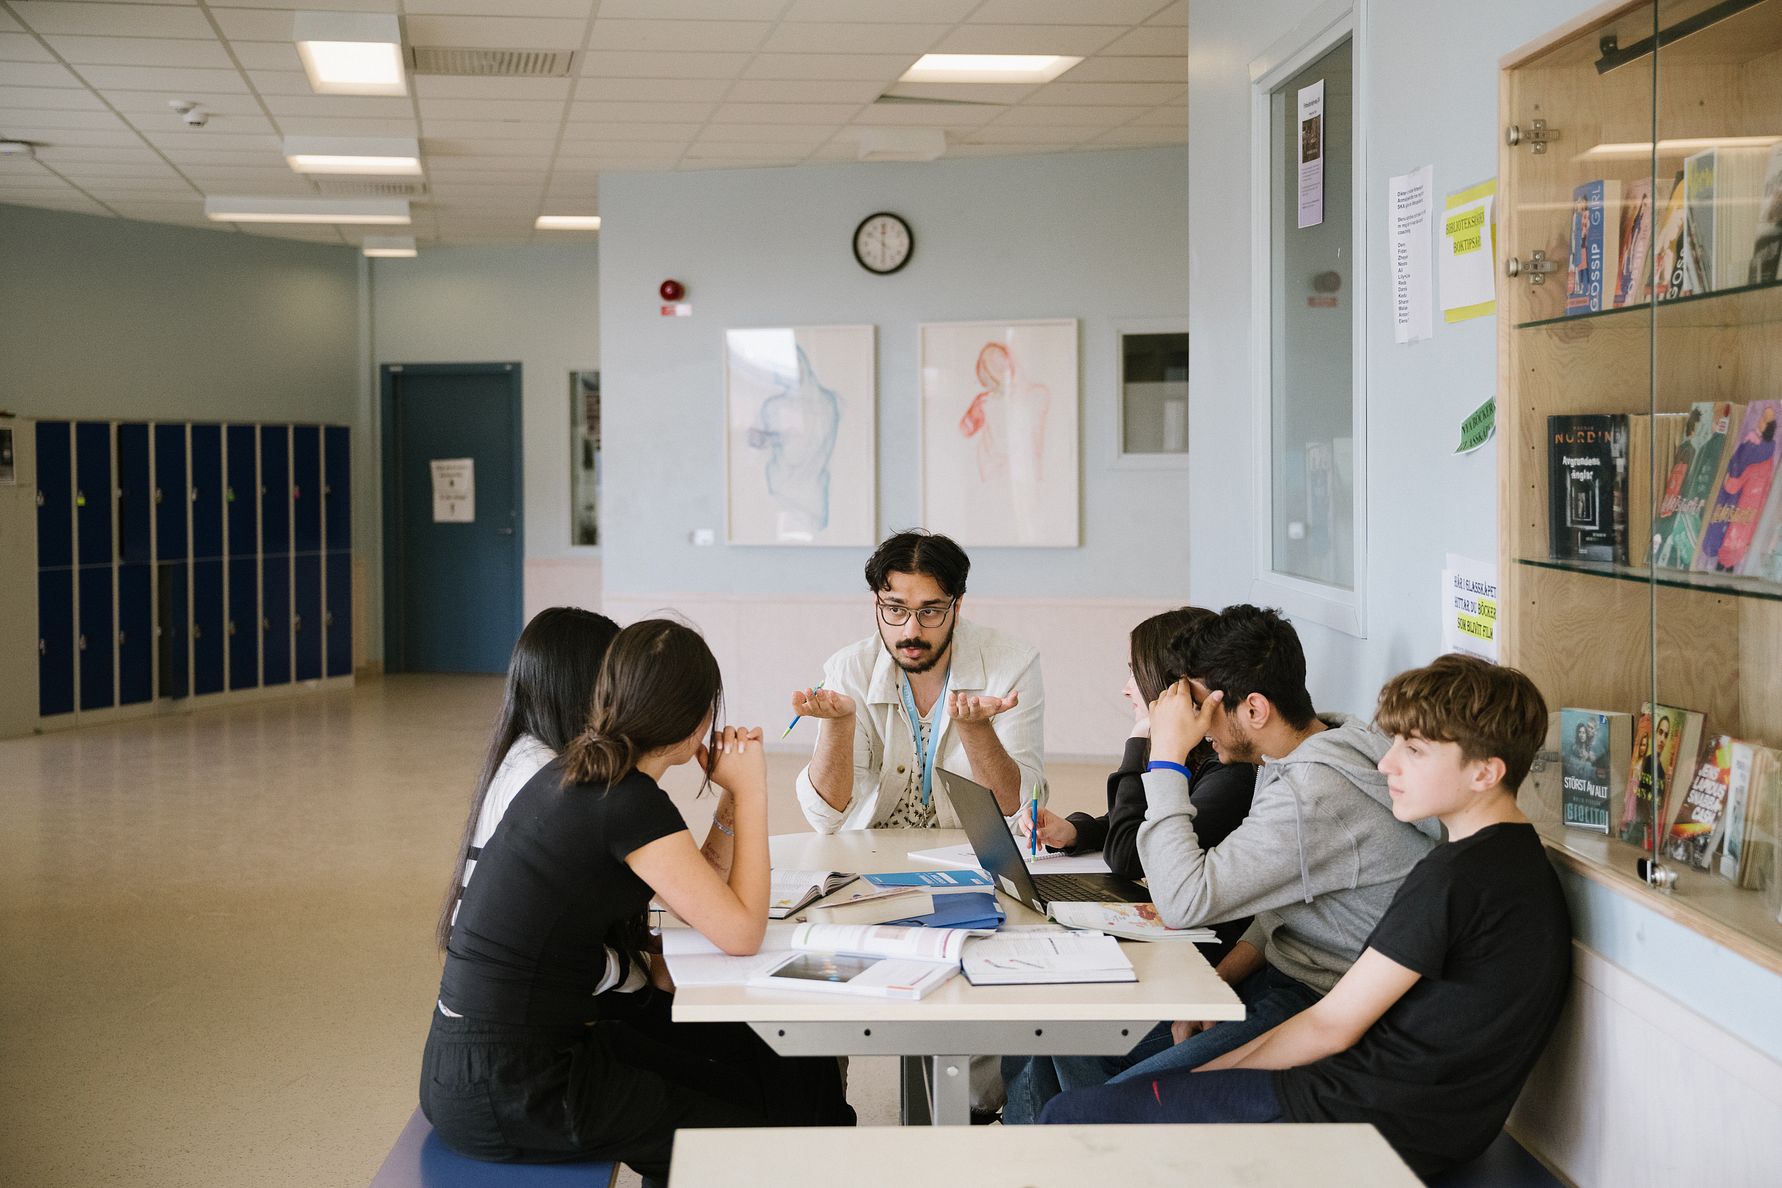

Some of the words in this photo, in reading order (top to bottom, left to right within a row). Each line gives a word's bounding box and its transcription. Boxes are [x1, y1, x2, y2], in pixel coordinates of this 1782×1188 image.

[1591, 185, 1601, 226] GIRL
[1590, 243, 1601, 312] GOSSIP
[1555, 431, 1612, 445] NORDIN
[1562, 456, 1600, 468] Avgrundens
[1454, 574, 1463, 589] HÄR
[1466, 579, 1497, 598] GLASSKÅPET
[1454, 596, 1470, 613] HITTAR
[1470, 601, 1477, 614] DU
[1478, 601, 1497, 620] BÖCKER
[1457, 617, 1466, 631] SOM
[1482, 625, 1493, 640] FILM
[1564, 775, 1587, 792] STÖRST
[1586, 781, 1595, 796] AV
[1595, 785, 1608, 798] ALLT
[1567, 803, 1605, 826] GIOLITO
